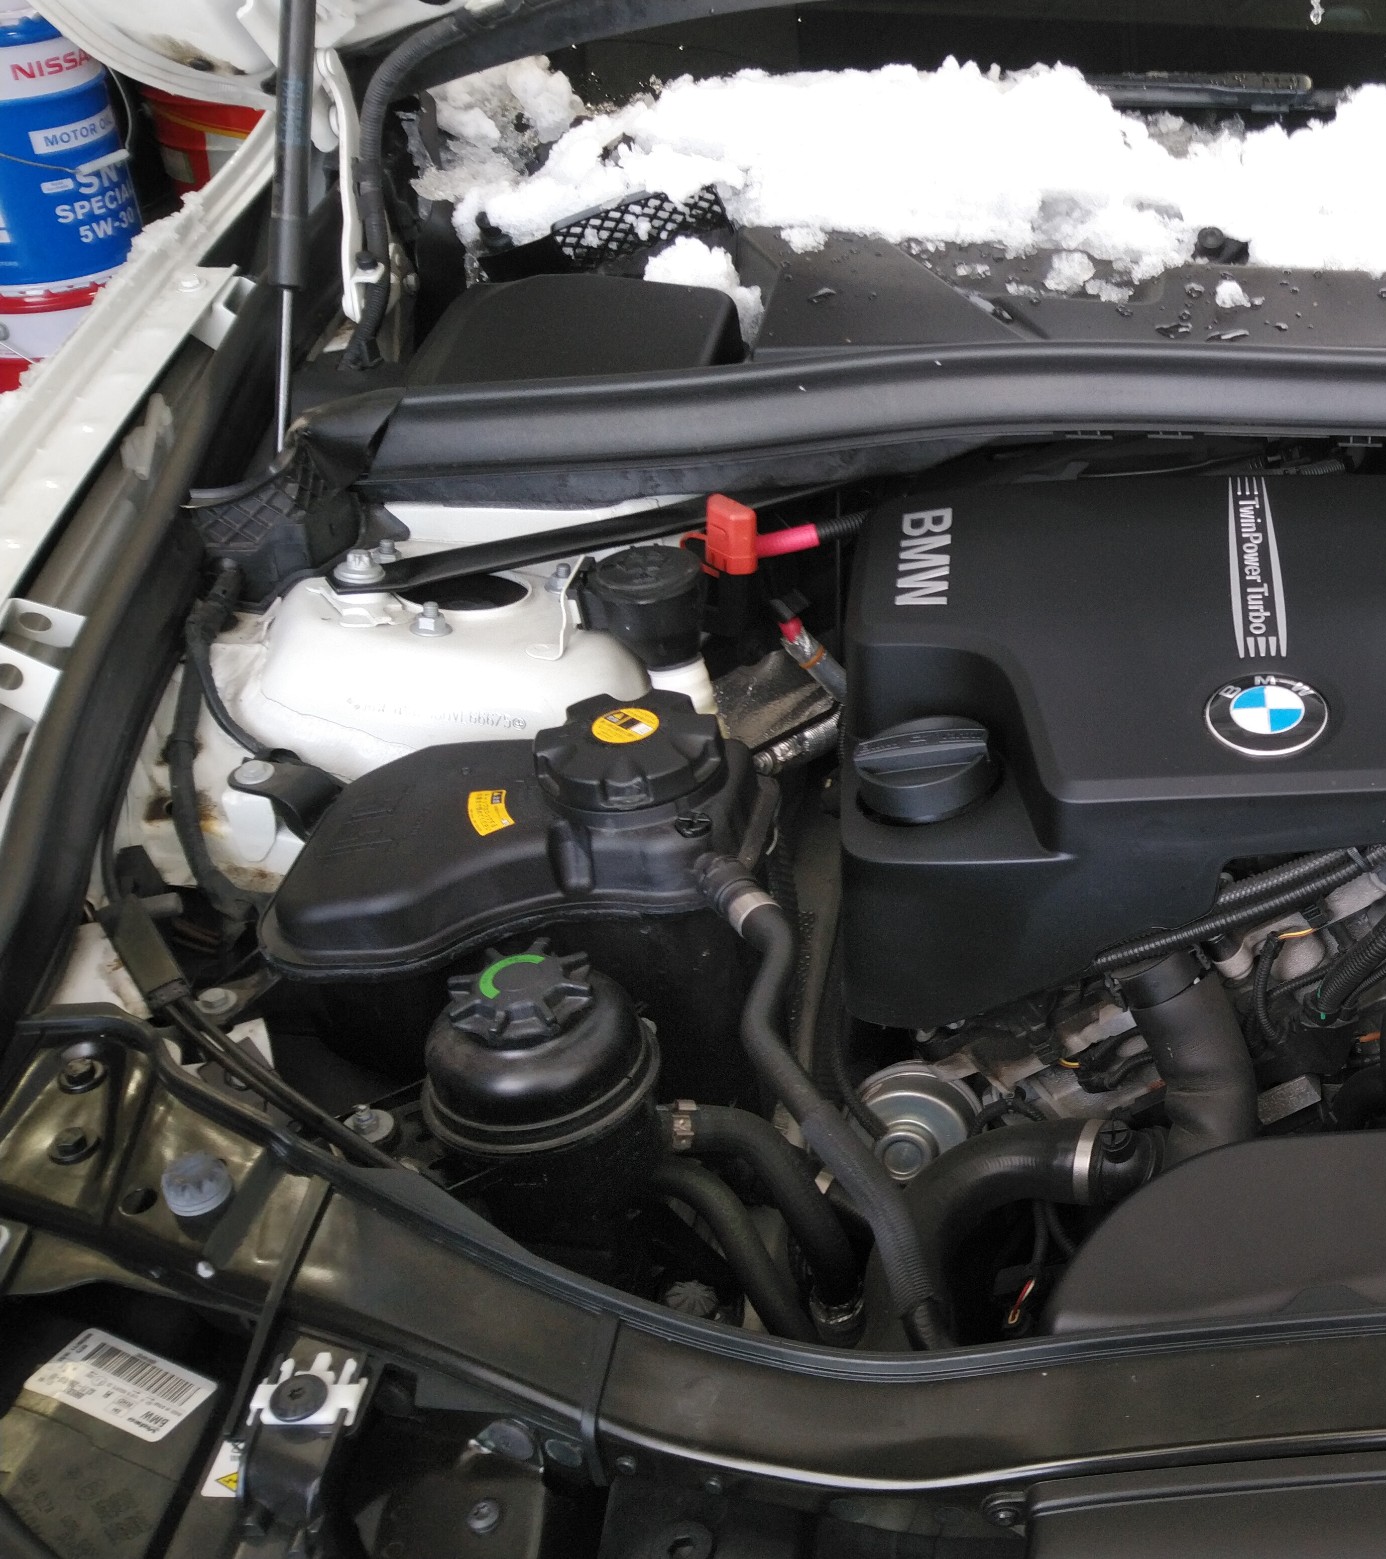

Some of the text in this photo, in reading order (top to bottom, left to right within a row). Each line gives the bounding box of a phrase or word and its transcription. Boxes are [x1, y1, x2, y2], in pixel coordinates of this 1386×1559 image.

[10, 49, 92, 81] NISSA
[43, 123, 98, 147] MOTOR
[79, 206, 135, 243] 5W-30
[894, 507, 953, 606] BMW
[1238, 497, 1270, 635] TwinPower Turbo
[1219, 675, 1313, 699] BMW
